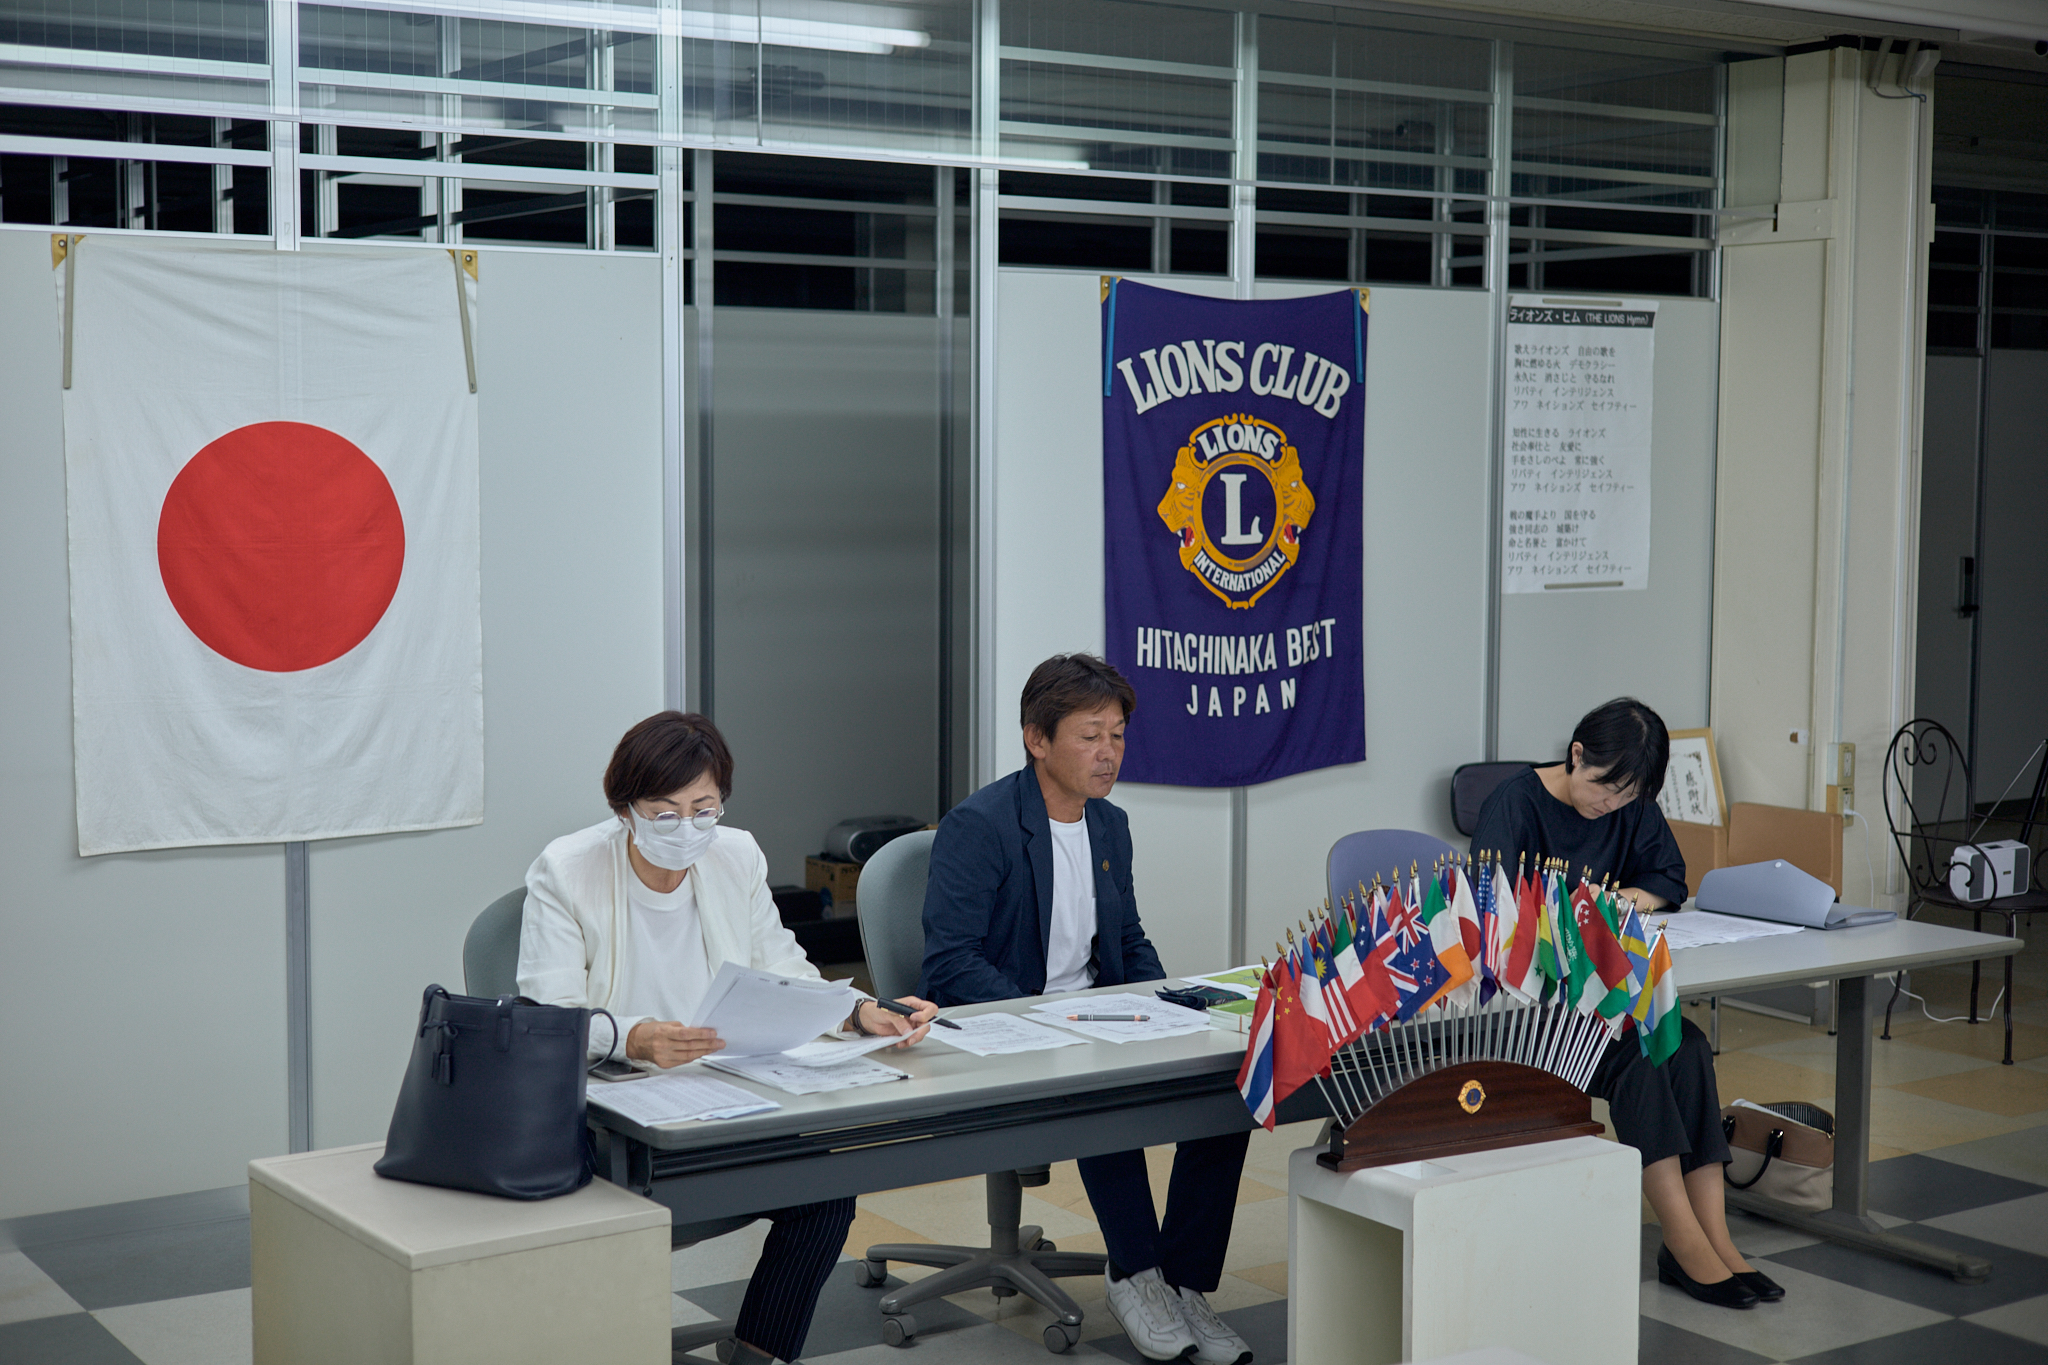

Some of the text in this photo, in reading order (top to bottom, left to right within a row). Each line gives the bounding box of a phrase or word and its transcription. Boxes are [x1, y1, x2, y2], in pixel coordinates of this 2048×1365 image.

[1509, 308, 1581, 323] ライオンズ・ヒム
[1604, 313, 1625, 325] LIONS
[1116, 339, 1351, 419] LIONS CLUB
[1196, 423, 1280, 461] LIONS
[1219, 473, 1264, 545] L
[1193, 550, 1287, 593] INTERNATIONAL
[1137, 618, 1336, 675] HITACHINAKA BEST
[1186, 677, 1296, 717] JAPAN
